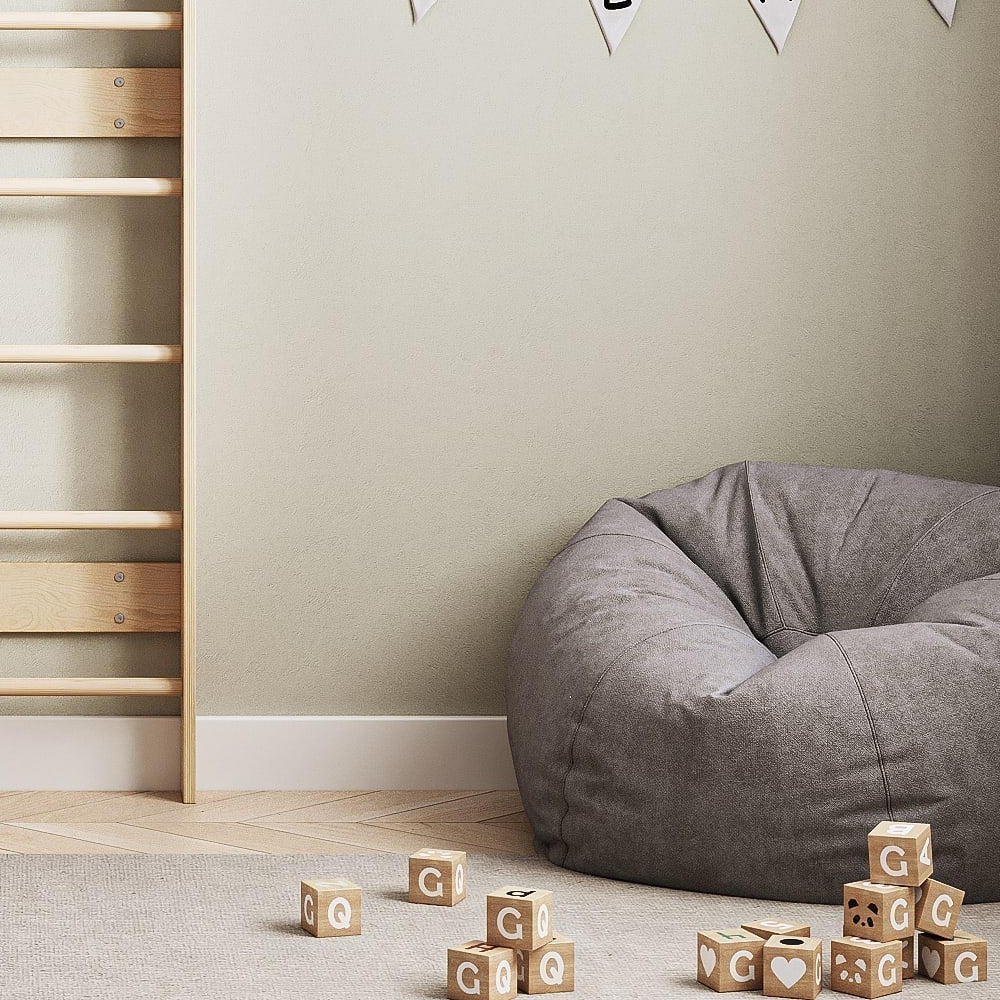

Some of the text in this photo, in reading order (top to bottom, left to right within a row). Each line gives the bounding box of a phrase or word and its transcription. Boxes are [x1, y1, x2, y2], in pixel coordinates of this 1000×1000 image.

[880, 845, 909, 877] G
[418, 867, 444, 898] G
[455, 863, 464, 895] Q
[304, 894, 314, 927] G
[327, 896, 352, 930] Q
[496, 906, 523, 940] G
[537, 903, 549, 939] Q
[889, 898, 909, 931] G
[931, 894, 954, 928] G
[456, 961, 481, 995] G
[495, 960, 512, 995] Q
[540, 951, 565, 985] Q
[729, 949, 755, 983] G
[878, 953, 897, 987] G
[954, 951, 979, 983] G
